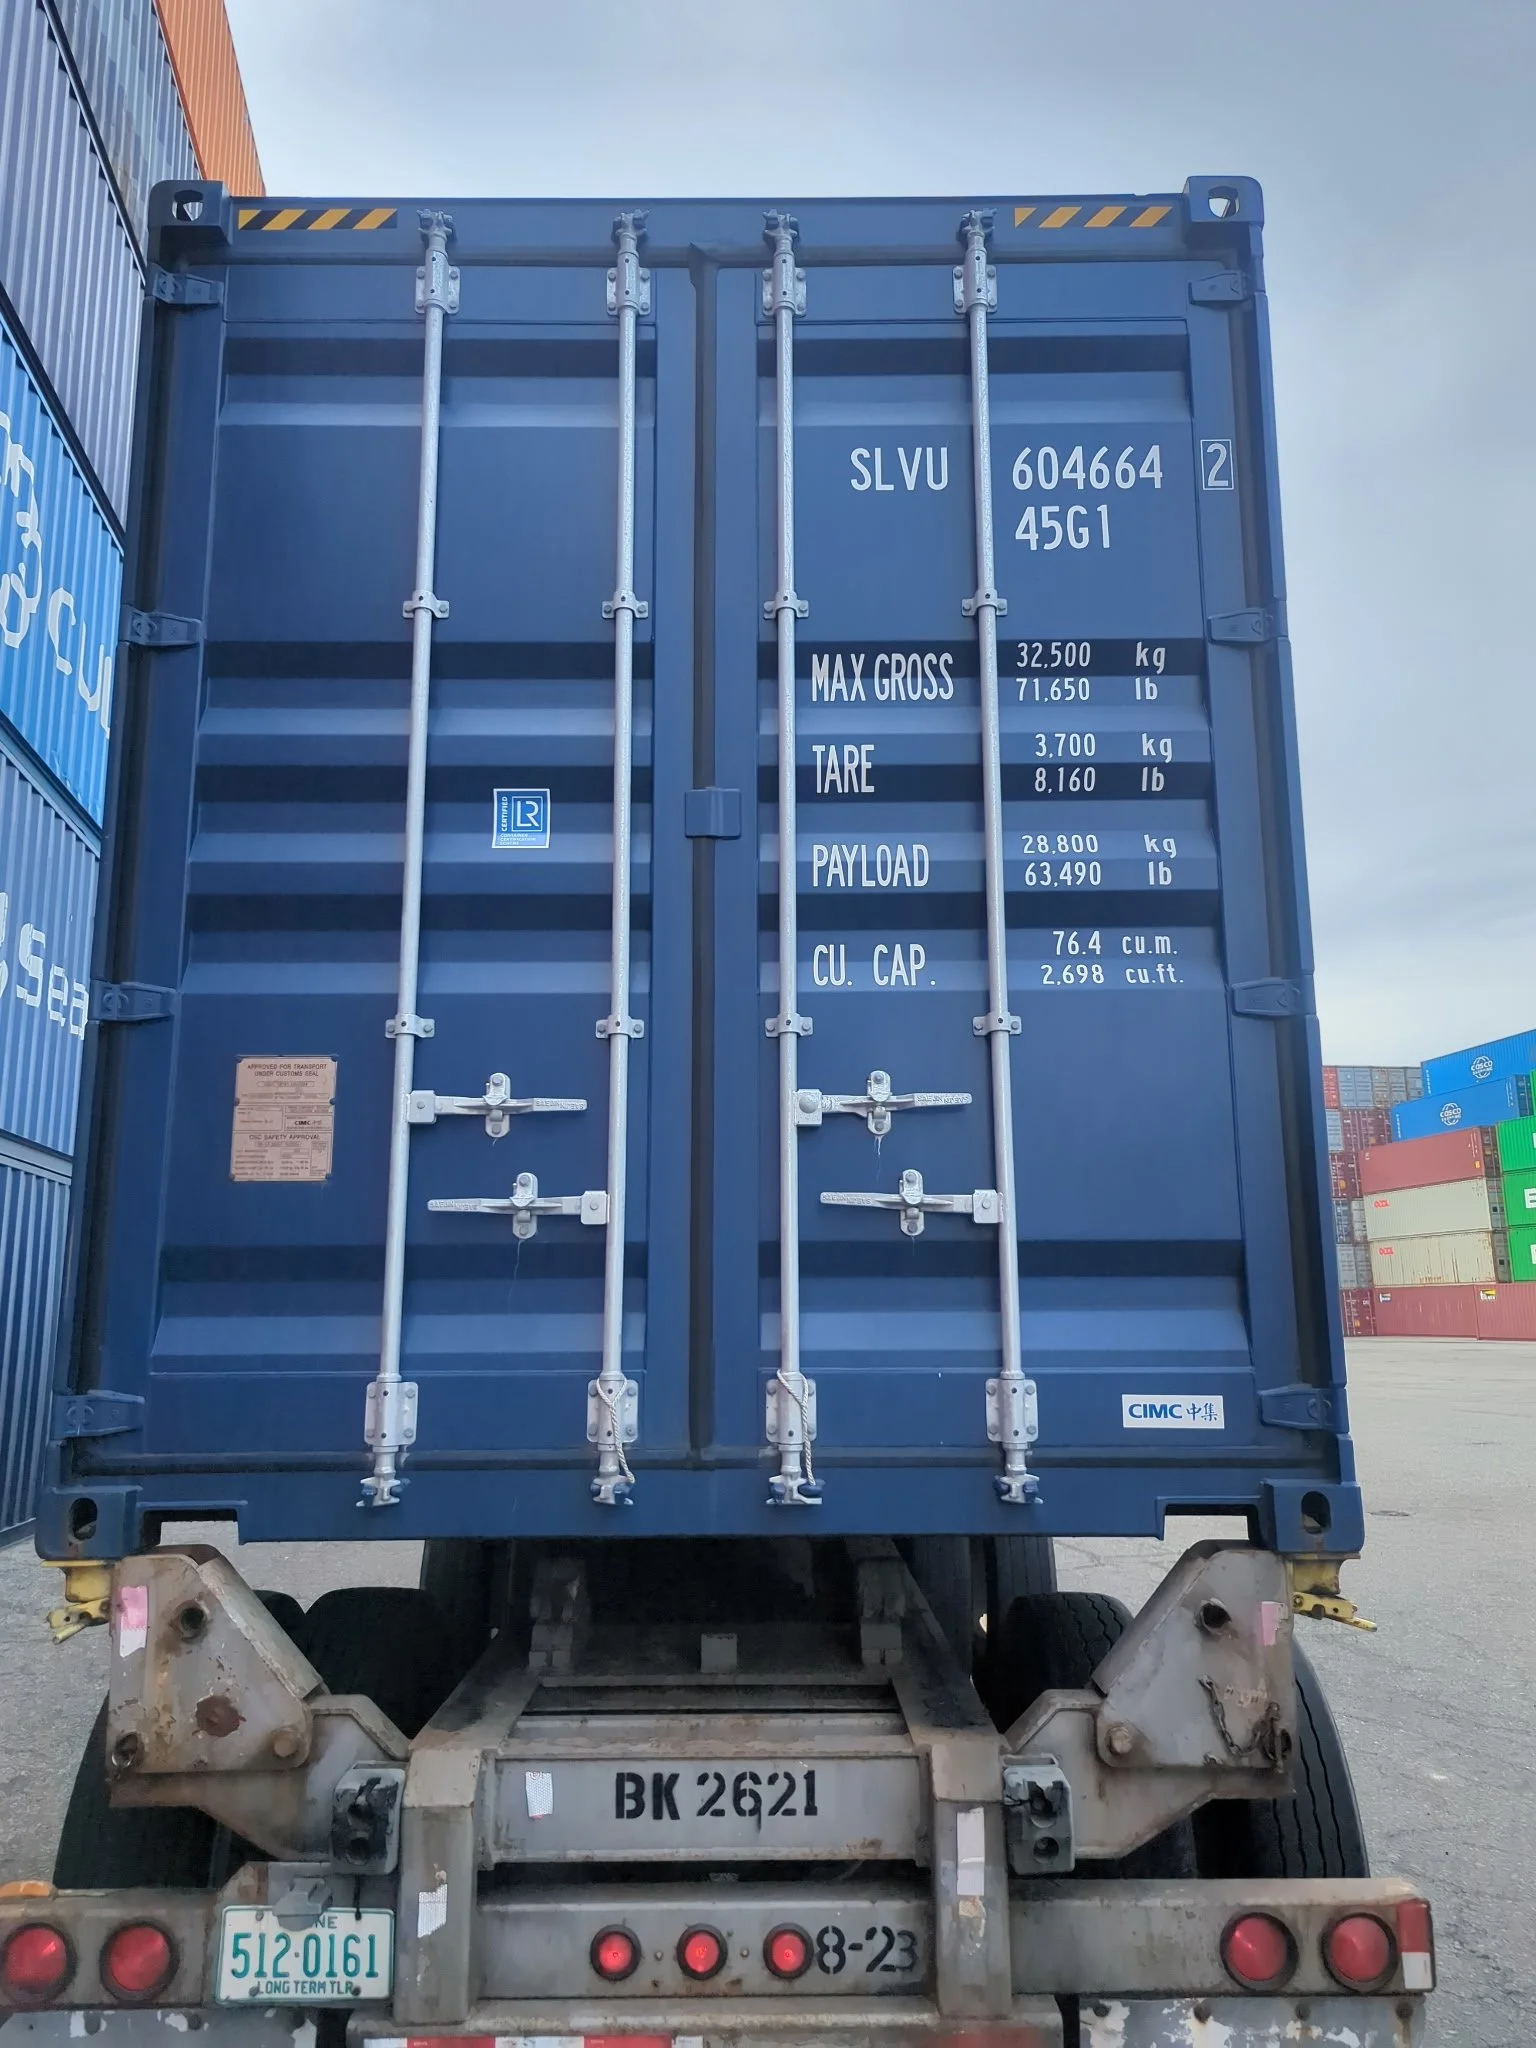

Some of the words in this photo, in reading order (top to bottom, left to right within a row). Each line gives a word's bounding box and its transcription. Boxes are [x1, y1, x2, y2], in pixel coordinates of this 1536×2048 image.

[850, 446, 949, 491] SLVU
[1012, 444, 1163, 491] 604664
[1206, 442, 1229, 487] 2
[1014, 503, 1111, 551] 45G1
[1016, 641, 1091, 669] 32,500
[1135, 641, 1166, 675] kg
[811, 653, 866, 702] MAX
[873, 652, 954, 702] GROSS
[1015, 677, 1090, 703] 71,650
[1135, 676, 1158, 701] lb
[1035, 732, 1096, 759] 3,700
[1141, 732, 1173, 764] kg
[811, 743, 875, 794] TARE
[1034, 766, 1096, 794] 8,160
[1141, 766, 1165, 792] lb
[516, 800, 540, 827] LR
[1021, 834, 1099, 856] 28,800
[1143, 833, 1177, 859] kg
[812, 843, 930, 888] PAYLOAD
[1024, 860, 1102, 887] 63,490
[1148, 860, 1172, 886] lb
[1052, 930, 1102, 956] 76.4
[1121, 935, 1178, 955] cu.m.
[813, 943, 853, 989] CU.
[873, 943, 936, 987] CAP.
[1040, 963, 1105, 986] 2,698
[1125, 963, 1184, 984] cu.ft.
[1471, 1060, 1493, 1071] COSCO
[1440, 1108, 1461, 1118] COSCO
[1128, 1403, 1183, 1419] CIMC
[1186, 1402, 1218, 1422] 中集
[615, 1772, 680, 1820] BK
[696, 1770, 818, 1818] 2621
[816, 1926, 918, 1976] 8-23
[257, 1980, 290, 1995] LONG
[294, 1980, 326, 1995] TERM
[329, 1980, 353, 1995] TLR
